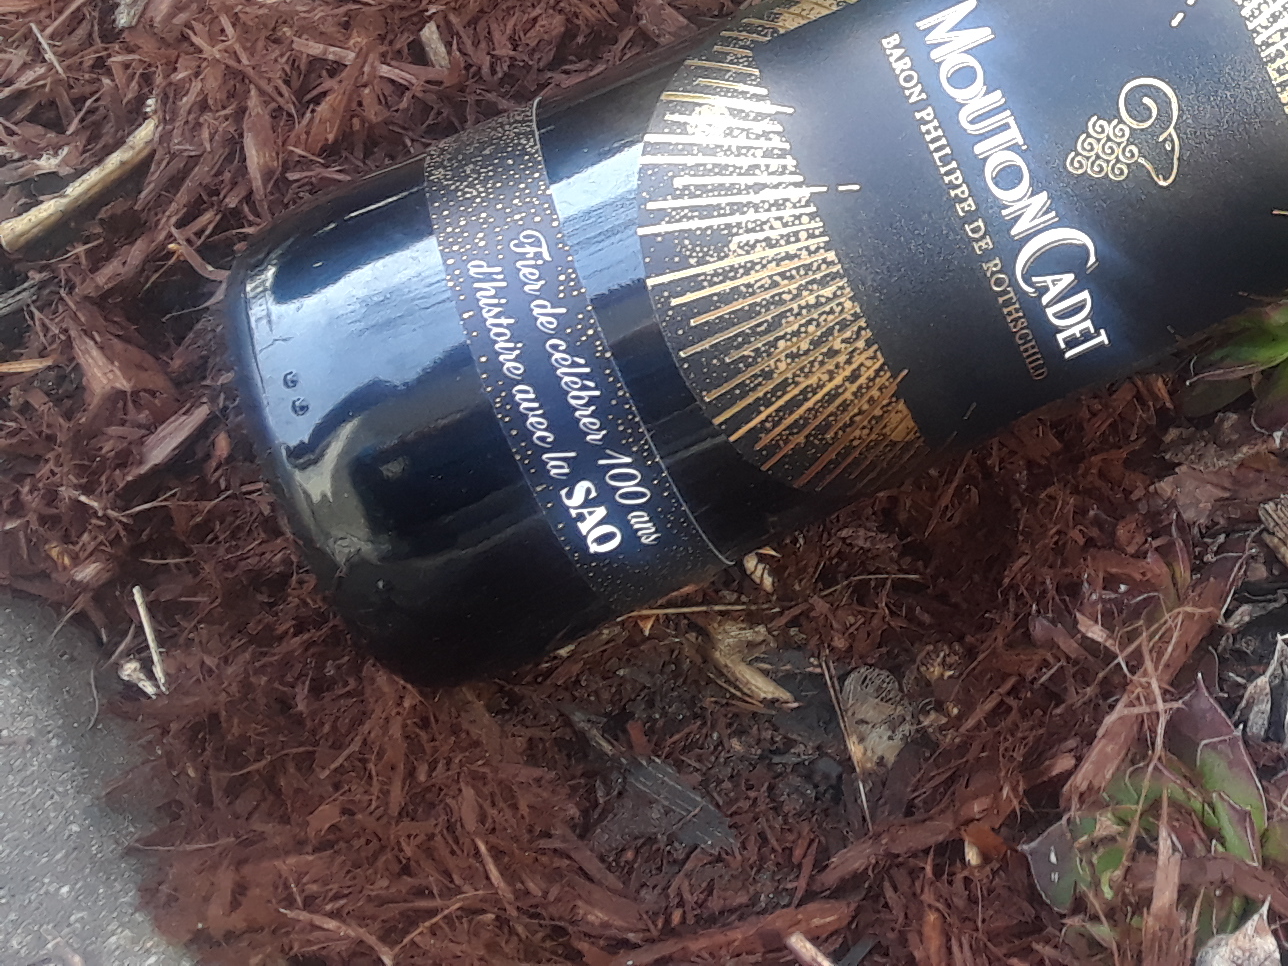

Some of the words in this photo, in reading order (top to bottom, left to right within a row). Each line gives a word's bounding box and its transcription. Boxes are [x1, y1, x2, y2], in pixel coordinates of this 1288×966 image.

[881, 33, 927, 105] BARON
[914, 105, 979, 218] PHILIPPE
[965, 218, 994, 256] DE
[982, 256, 1050, 382] ROTHSCHILD
[510, 228, 552, 297] Fier
[1015, 227, 1112, 361] CADET
[529, 298, 566, 334] de
[468, 258, 527, 380] d'histoire
[511, 383, 556, 449] avec
[540, 449, 578, 480] la
[559, 480, 623, 554] SAQ
[545, 336, 604, 446] célébrer
[599, 448, 652, 508] 100
[626, 510, 662, 545] ans
